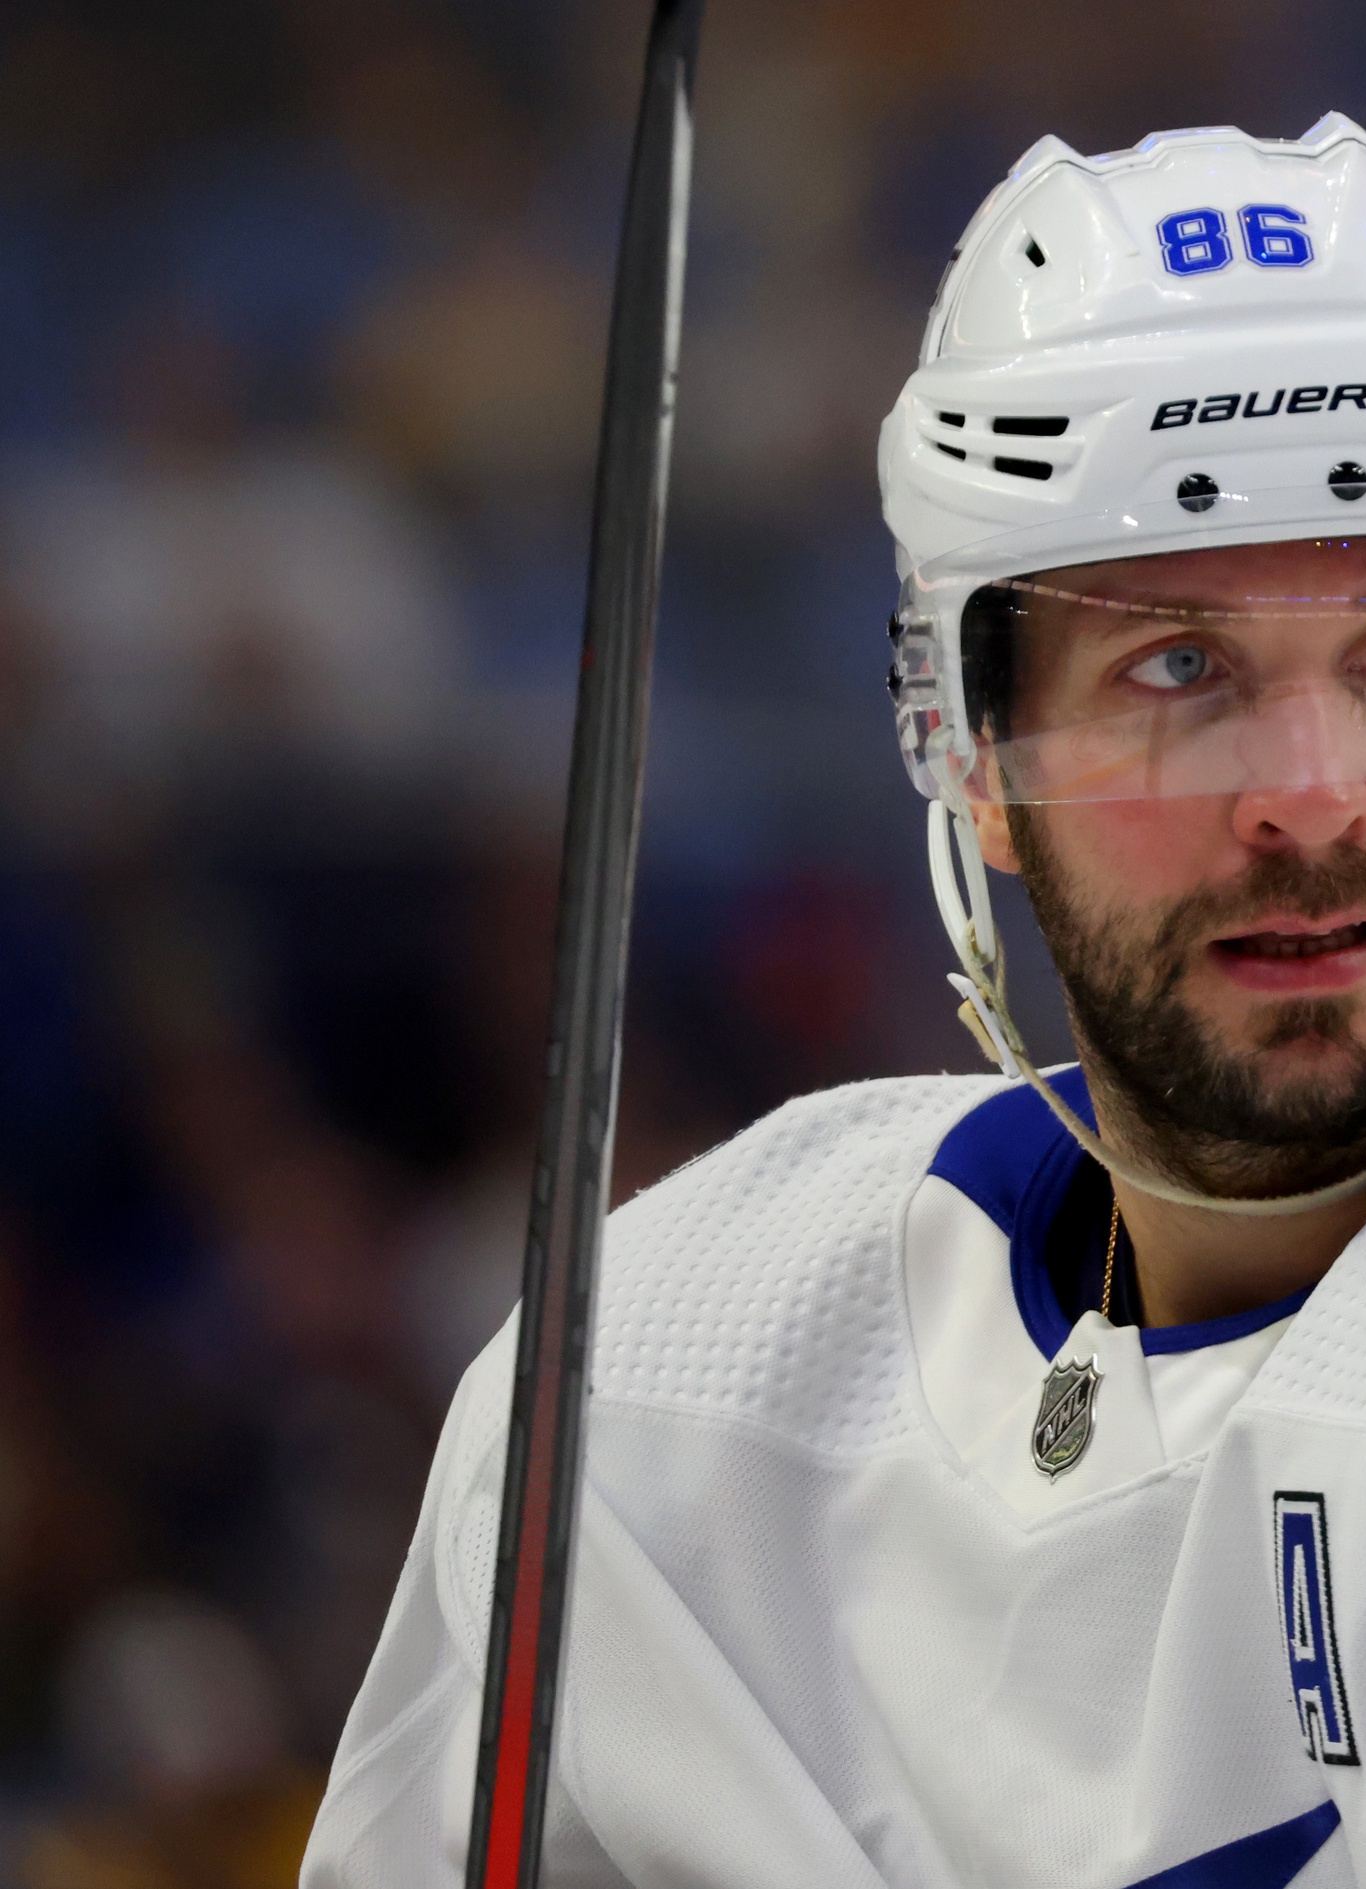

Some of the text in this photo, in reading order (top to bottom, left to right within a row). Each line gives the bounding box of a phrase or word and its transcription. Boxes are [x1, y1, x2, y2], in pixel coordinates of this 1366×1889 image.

[1156, 203, 1315, 277] 86
[1041, 1386, 1087, 1456] NHL
[1273, 1490, 1361, 1767] A
